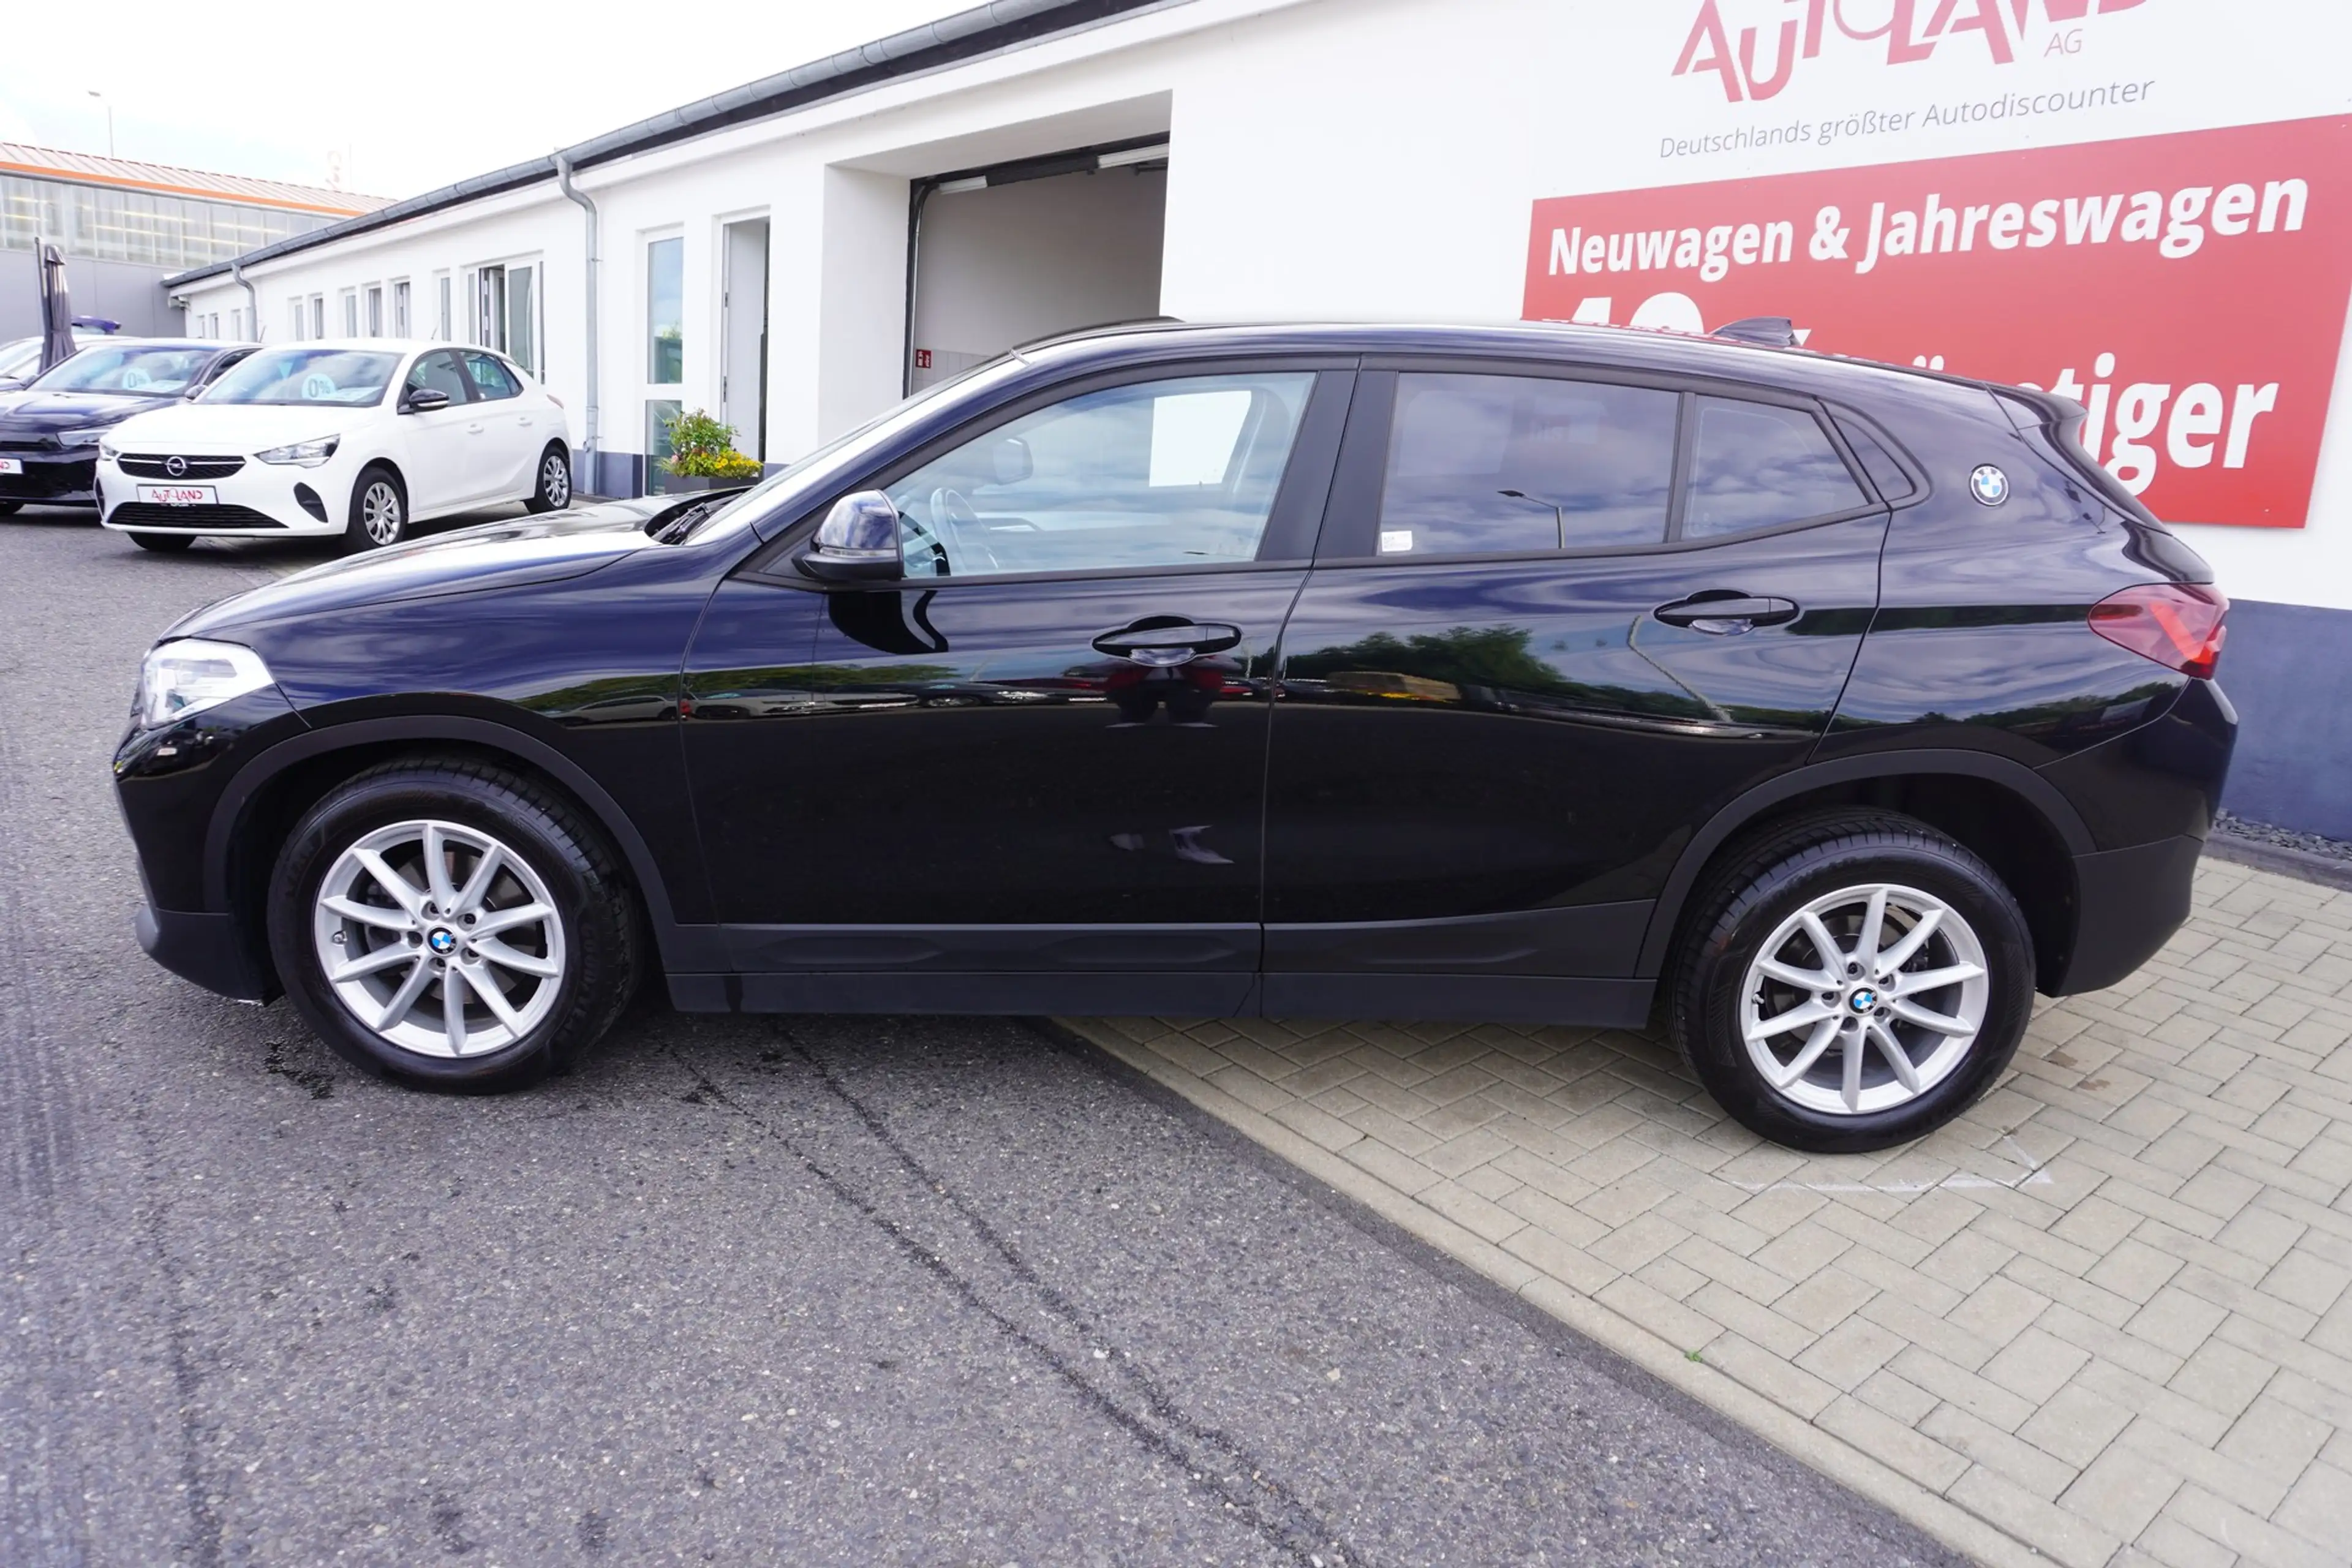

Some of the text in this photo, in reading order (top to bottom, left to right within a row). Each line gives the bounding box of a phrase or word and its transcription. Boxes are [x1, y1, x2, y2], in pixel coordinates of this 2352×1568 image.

[1672, 0, 2145, 102] AUTOLA
[2043, 28, 2083, 58] AG
[1660, 80, 2156, 159] Deutschlands größter Autodiscounter
[1548, 177, 2309, 282] Neuwagen & Jahreswagen
[152, 488, 203, 502] AUTOLAND
